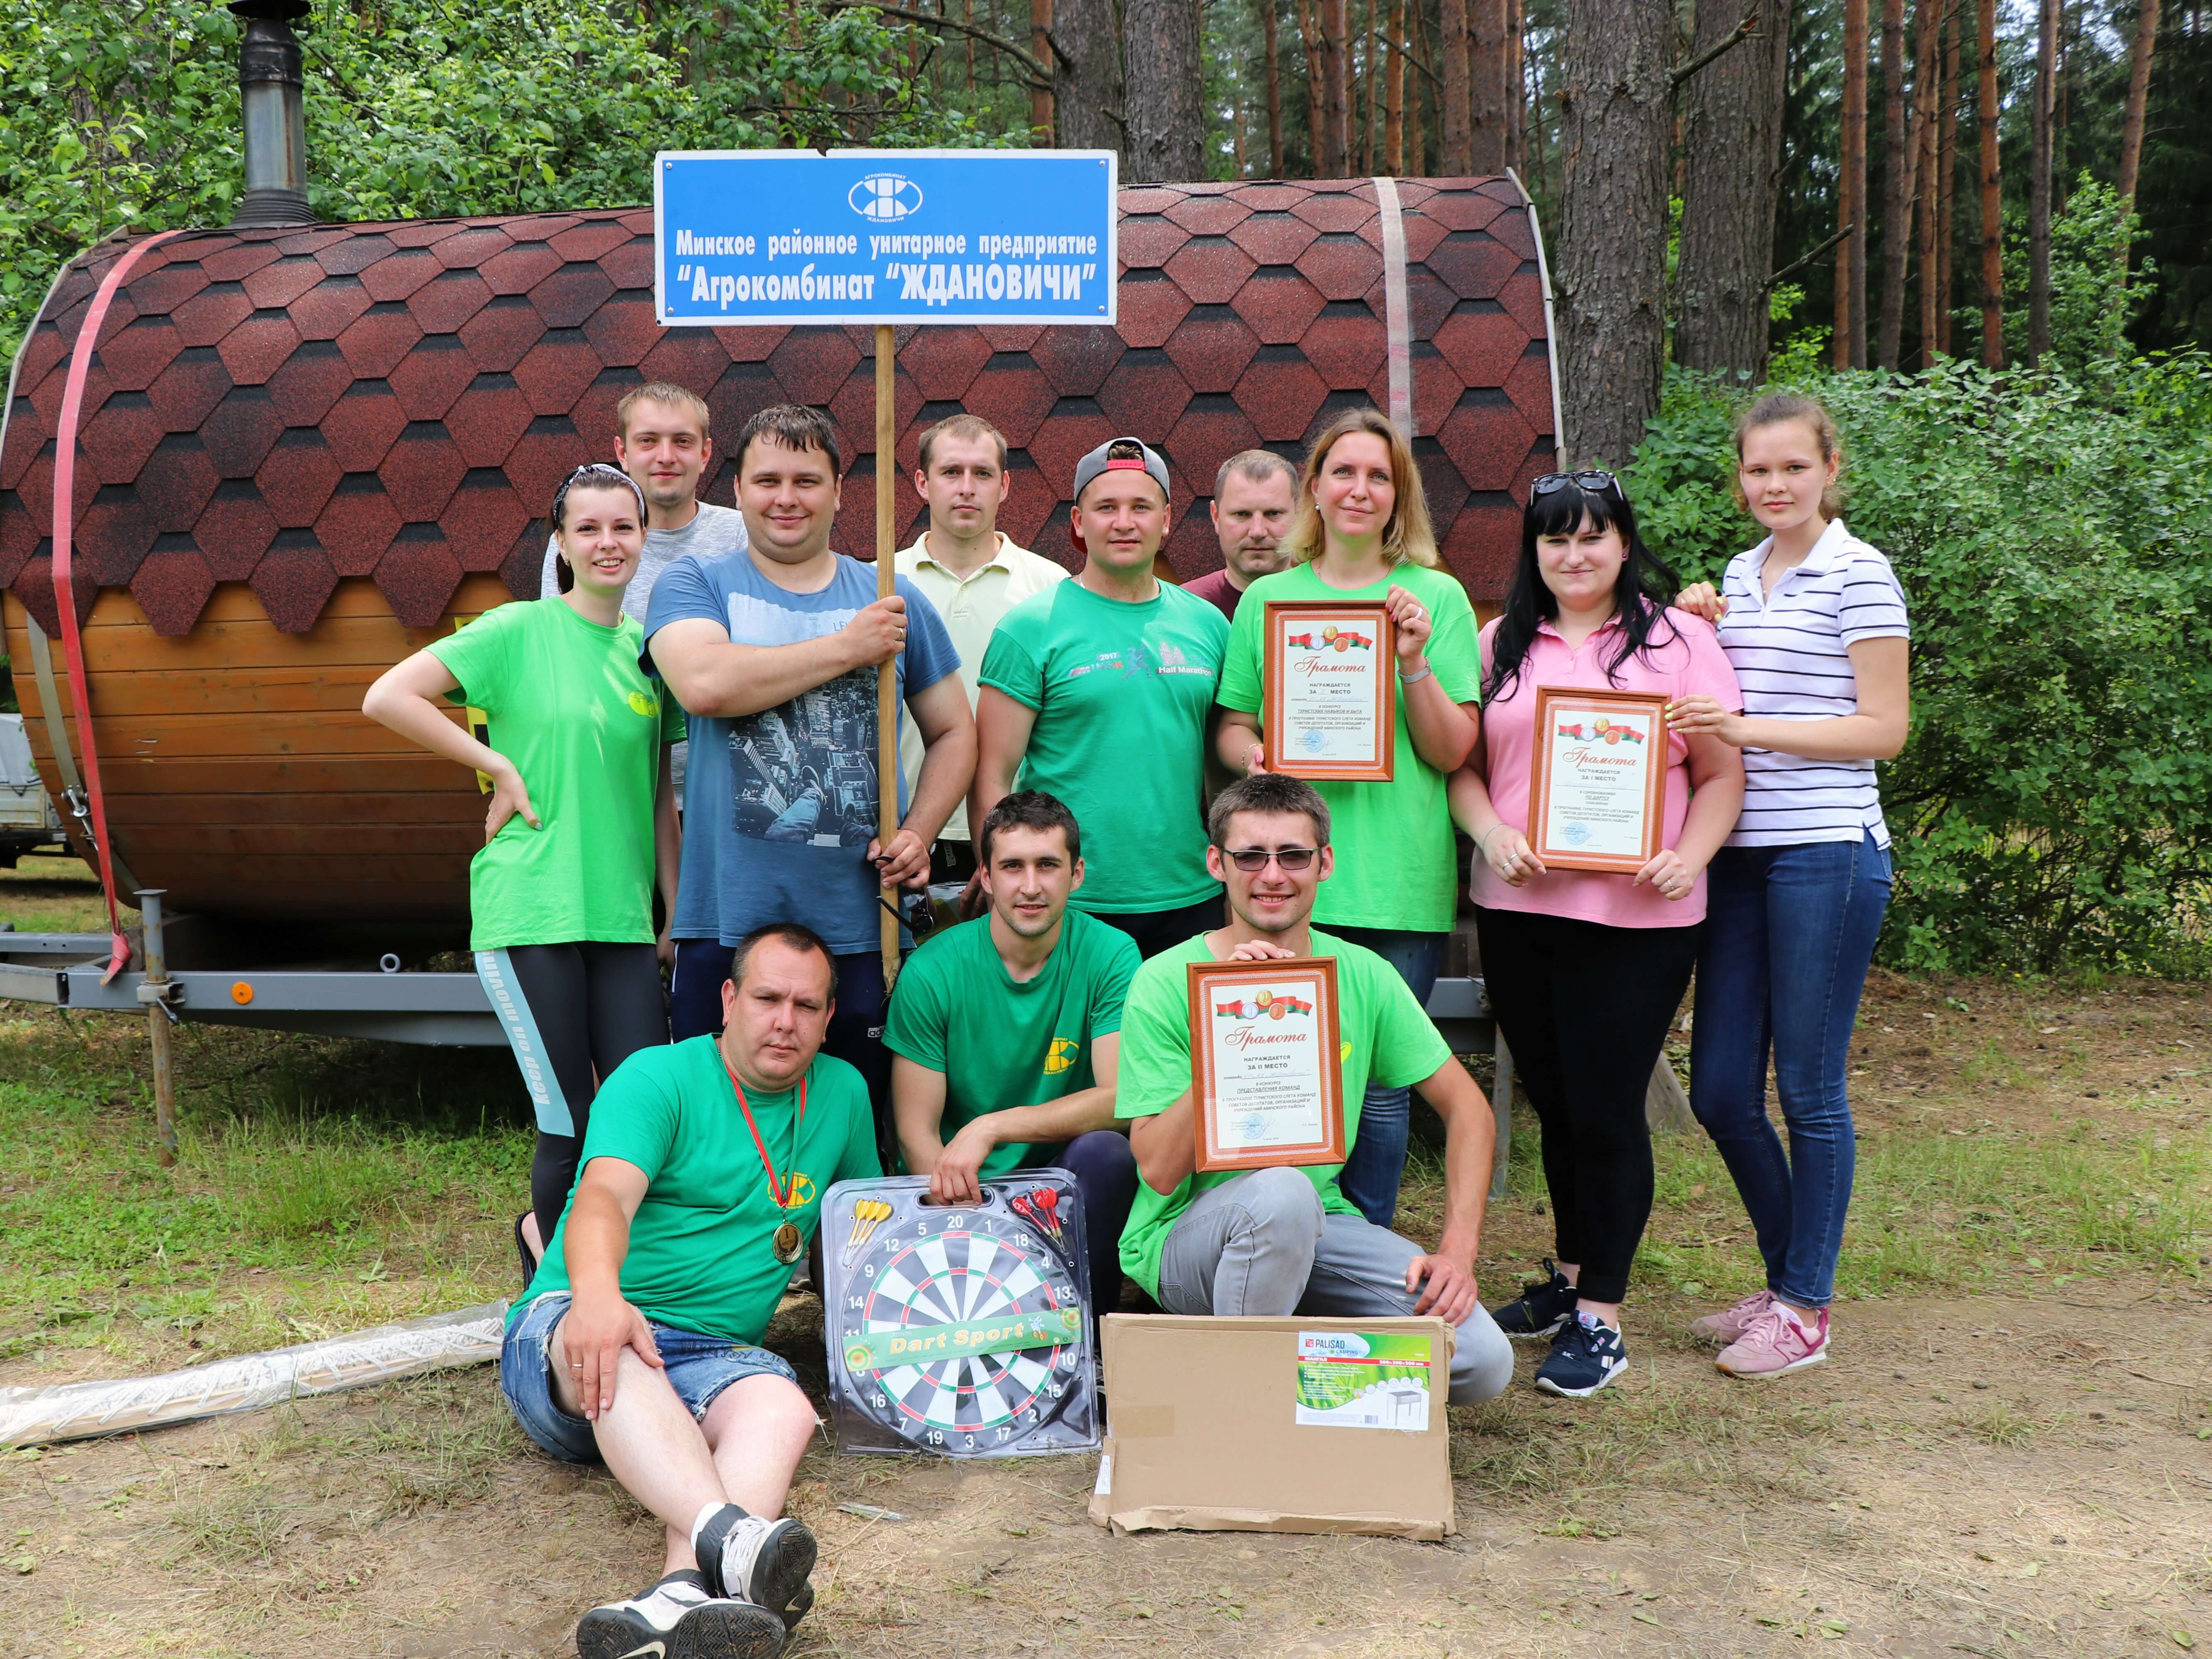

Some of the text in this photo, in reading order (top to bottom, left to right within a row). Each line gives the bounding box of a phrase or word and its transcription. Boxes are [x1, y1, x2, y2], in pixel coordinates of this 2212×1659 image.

[676, 229, 1097, 261] Минское районное унитарное предприятие
[1178, 667, 1212, 676] Marathon
[1294, 656, 1366, 677] Грамота
[1562, 747, 1637, 768] Грамота
[512, 1027, 530, 1051] on
[1225, 1026, 1307, 1051] Грамота
[524, 1056, 550, 1104] keep
[947, 1215, 964, 1229] 20
[985, 1220, 992, 1233] 1
[917, 1223, 927, 1236] 5
[884, 1238, 900, 1252] 12
[1013, 1233, 1029, 1247] 18
[1040, 1256, 1050, 1269] 4
[864, 1264, 874, 1277] 9
[1054, 1286, 1071, 1300] 13
[848, 1296, 864, 1309] 14
[889, 1332, 947, 1355] Dart
[953, 1322, 1024, 1347] Sport
[1316, 1339, 1345, 1349] PALISAD
[1059, 1352, 1076, 1366] 10
[1046, 1384, 1061, 1398] 15
[870, 1394, 886, 1408] 16
[1028, 1409, 1037, 1423] 2
[899, 1417, 908, 1431] 7
[927, 1430, 943, 1445] 19
[995, 1427, 1011, 1441] 17
[965, 1435, 974, 1449] 3
